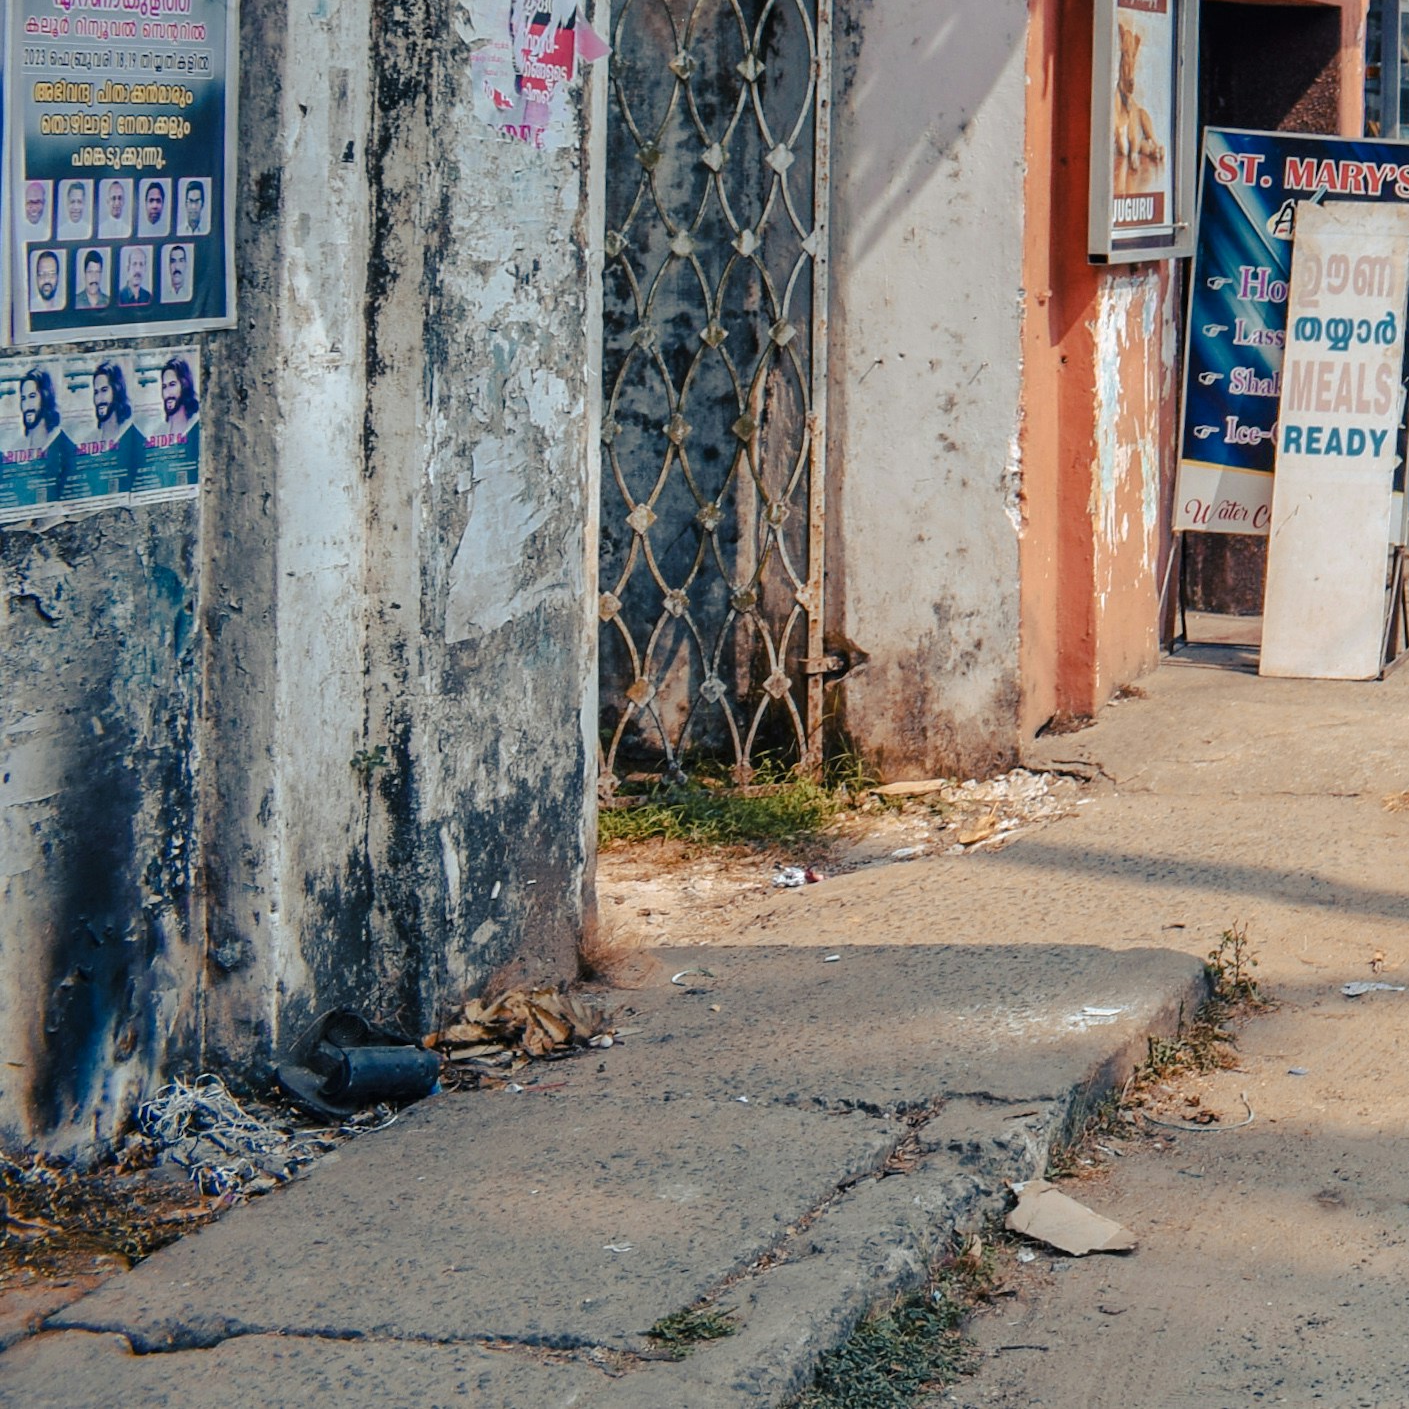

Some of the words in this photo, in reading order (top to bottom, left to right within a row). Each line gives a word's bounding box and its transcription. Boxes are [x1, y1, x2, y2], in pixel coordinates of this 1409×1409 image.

[24, 48, 45, 66] 2023
[1215, 153, 1272, 186] ST.
[1294, 311, 1397, 351] തയ്യാർ
[1288, 360, 1392, 416] MEALS
[1283, 425, 1389, 457] READY
[1185, 498, 1249, 524] Water
